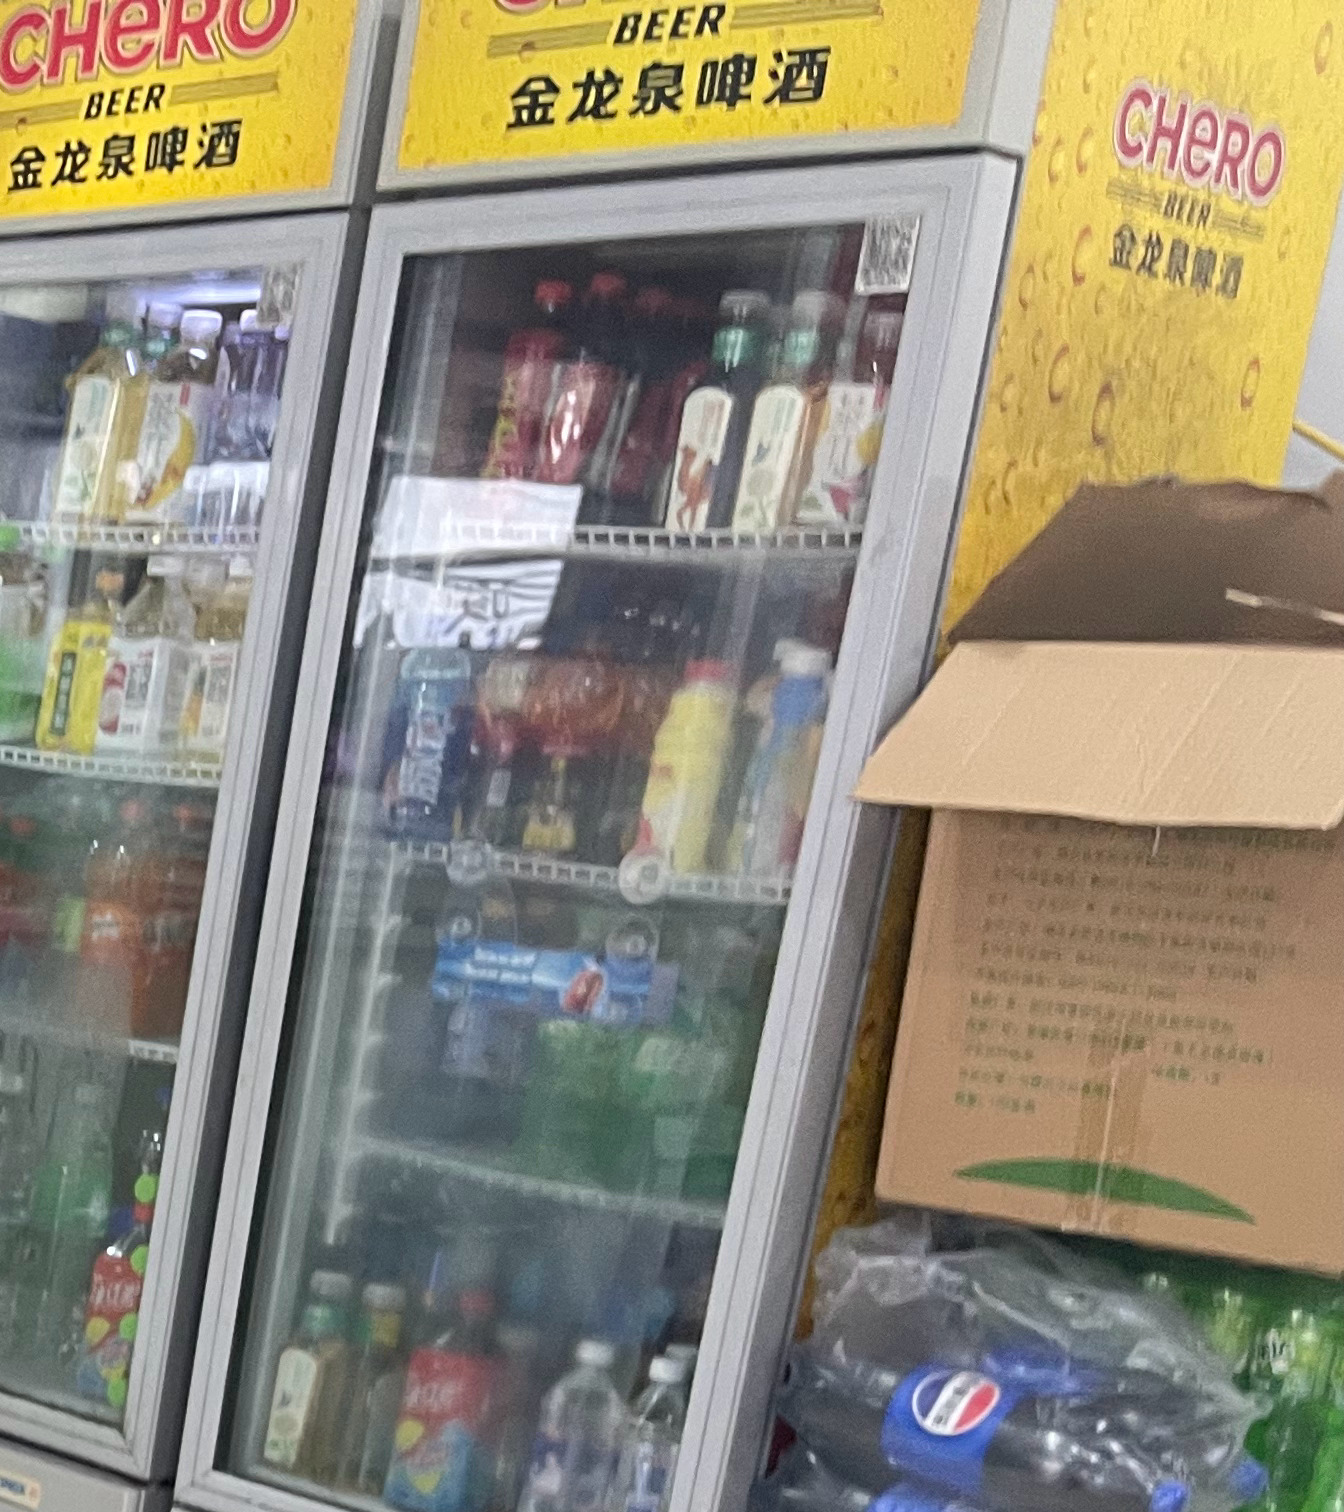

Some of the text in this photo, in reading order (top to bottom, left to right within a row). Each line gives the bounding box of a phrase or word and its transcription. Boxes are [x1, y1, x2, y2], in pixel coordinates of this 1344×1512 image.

[613, 4, 726, 45] BEER
[83, 83, 167, 120] BEER
[506, 46, 832, 130] 金龙泉啤酒
[6, 119, 244, 192] 金龙泉啤酒
